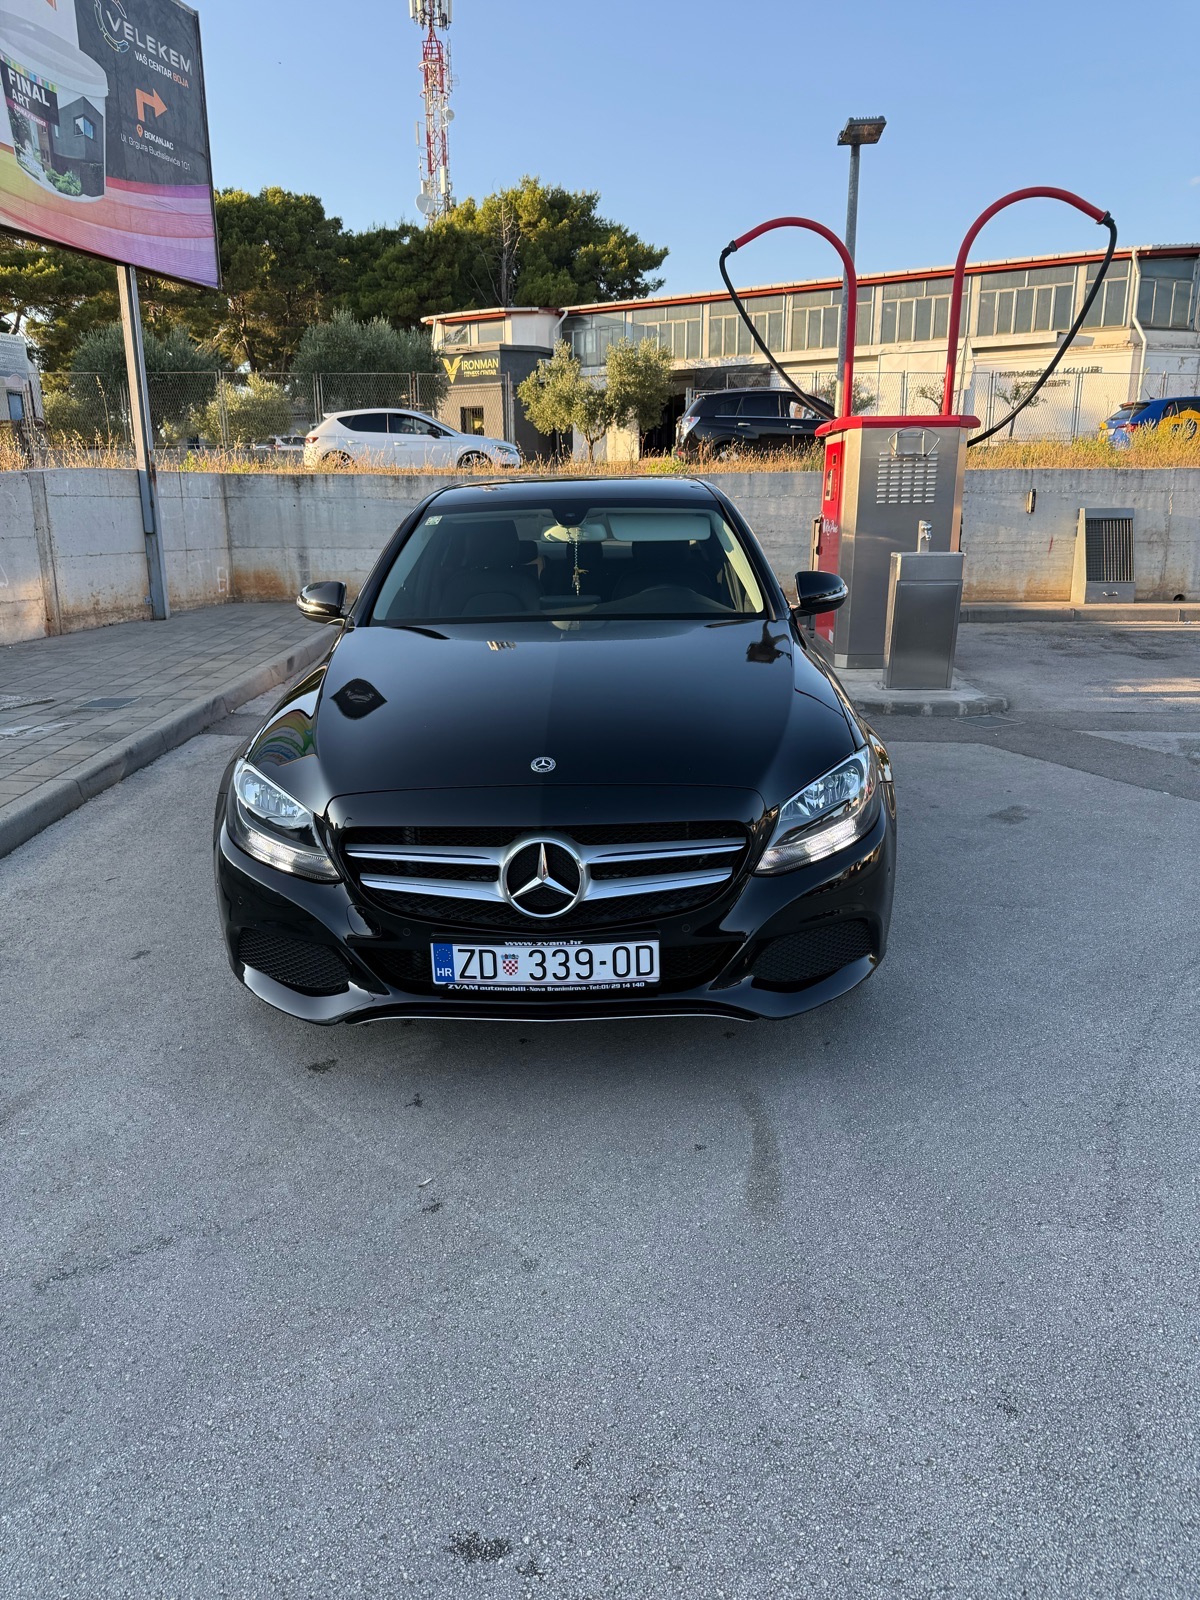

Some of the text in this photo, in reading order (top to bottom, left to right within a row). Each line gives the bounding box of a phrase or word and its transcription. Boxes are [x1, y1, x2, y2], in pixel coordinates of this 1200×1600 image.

[106, 10, 193, 76] VELEKEM
[134, 51, 189, 88] VAŠ CENTAR BOJA
[7, 67, 50, 107] FINAL
[12, 88, 30, 109] ART
[144, 130, 174, 150] BOKANJAC
[181, 160, 191, 171] 101
[461, 358, 498, 370] IRONMAN
[437, 967, 452, 977] HR
[457, 945, 654, 981] ZD 339-OD
